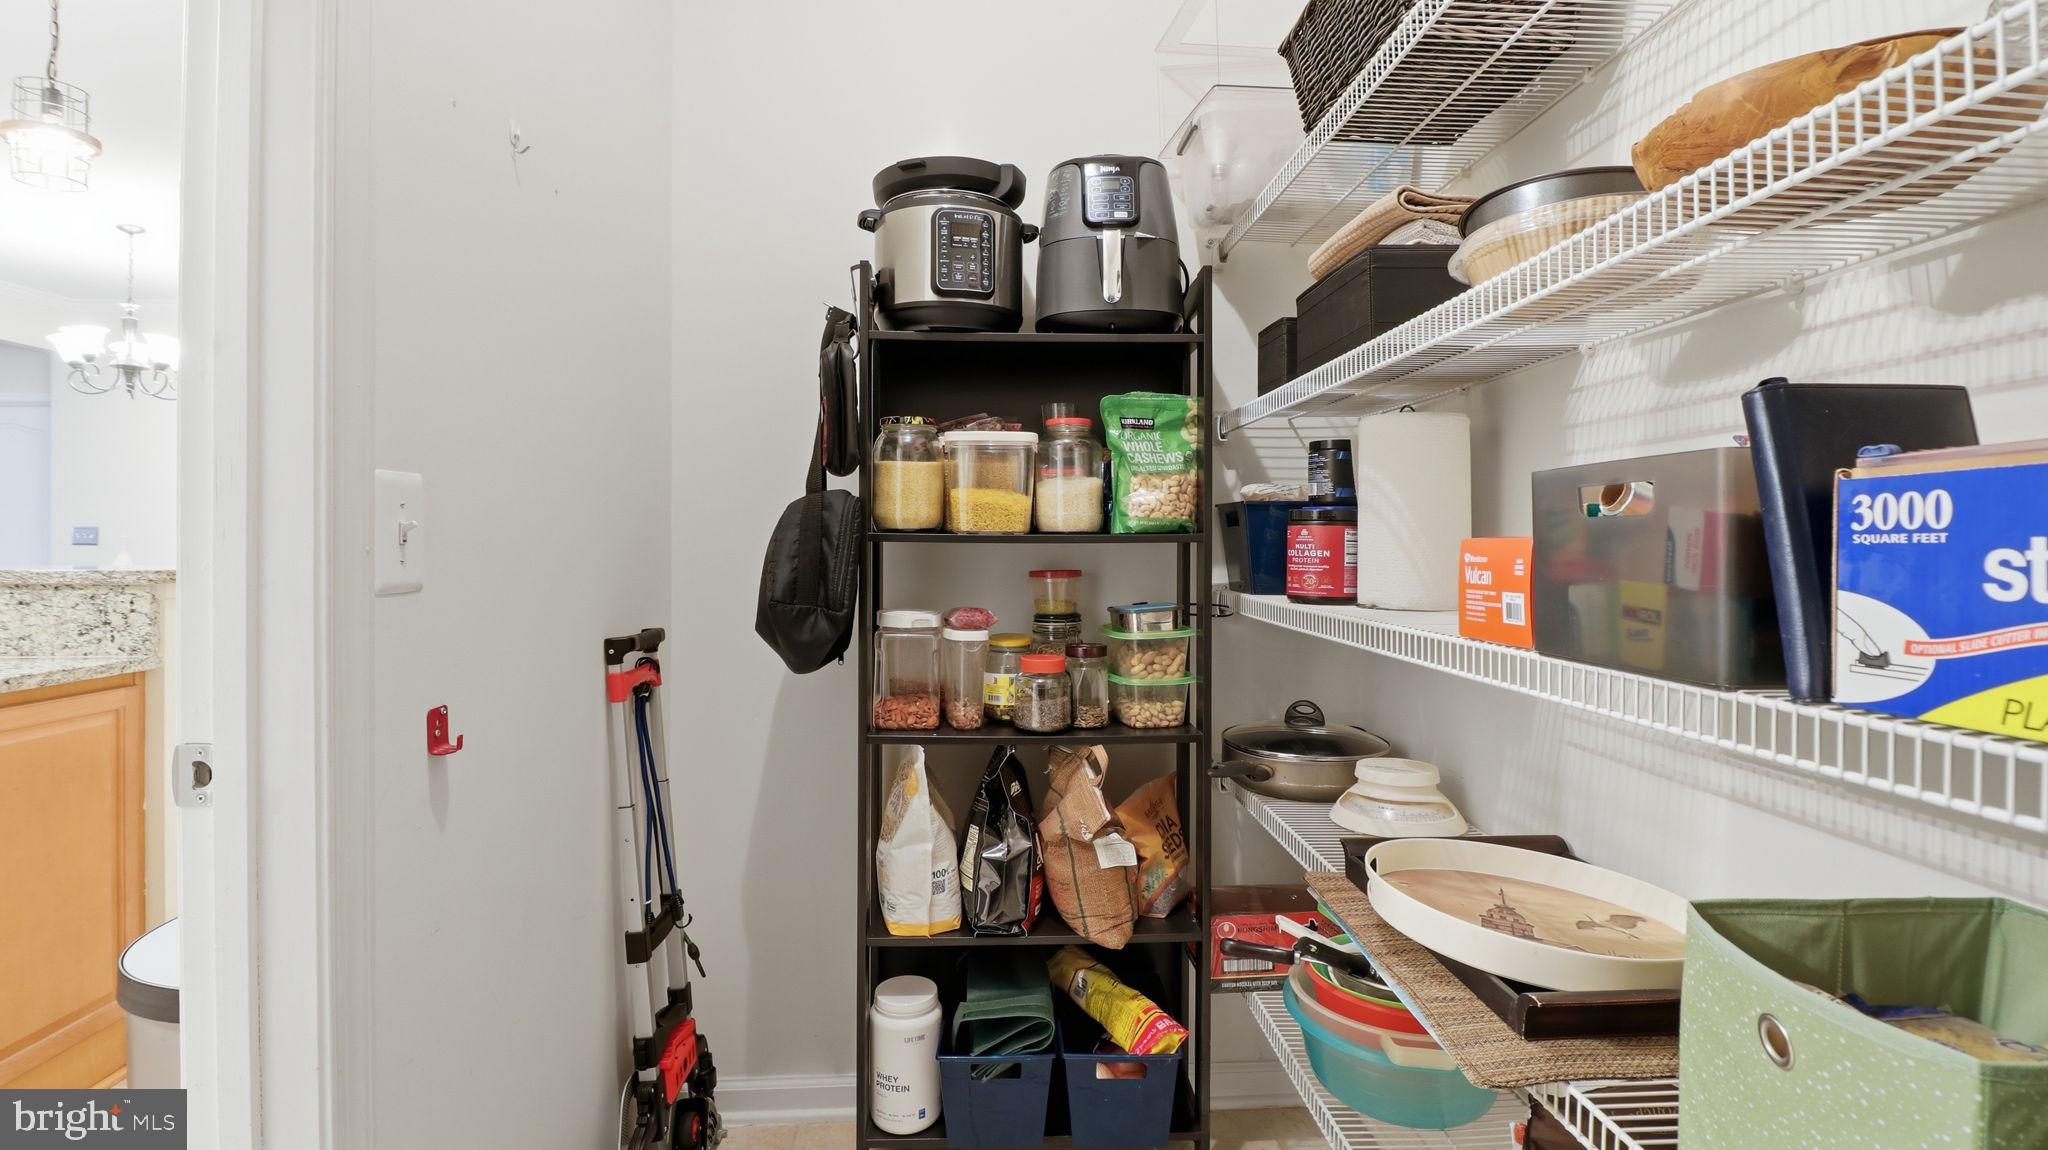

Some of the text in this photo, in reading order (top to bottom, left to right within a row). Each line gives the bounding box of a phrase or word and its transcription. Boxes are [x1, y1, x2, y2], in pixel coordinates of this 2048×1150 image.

[1121, 418, 1154, 426] KIRKLAND
[1120, 431, 1162, 441] ORGANIC
[1122, 441, 1163, 452] WHOLE
[1127, 451, 1184, 464] CASHEWS
[1851, 489, 1954, 532] 3000
[1852, 532, 1949, 545] SQUARE FEET
[1465, 566, 1492, 585] Vulcan
[1911, 643, 1957, 654] OPTIONAL
[1959, 638, 1988, 651] SLIDE
[2001, 698, 2048, 732] PL
[876, 1071, 899, 1084] WHEY
[876, 1080, 910, 1093] PROTEIN
